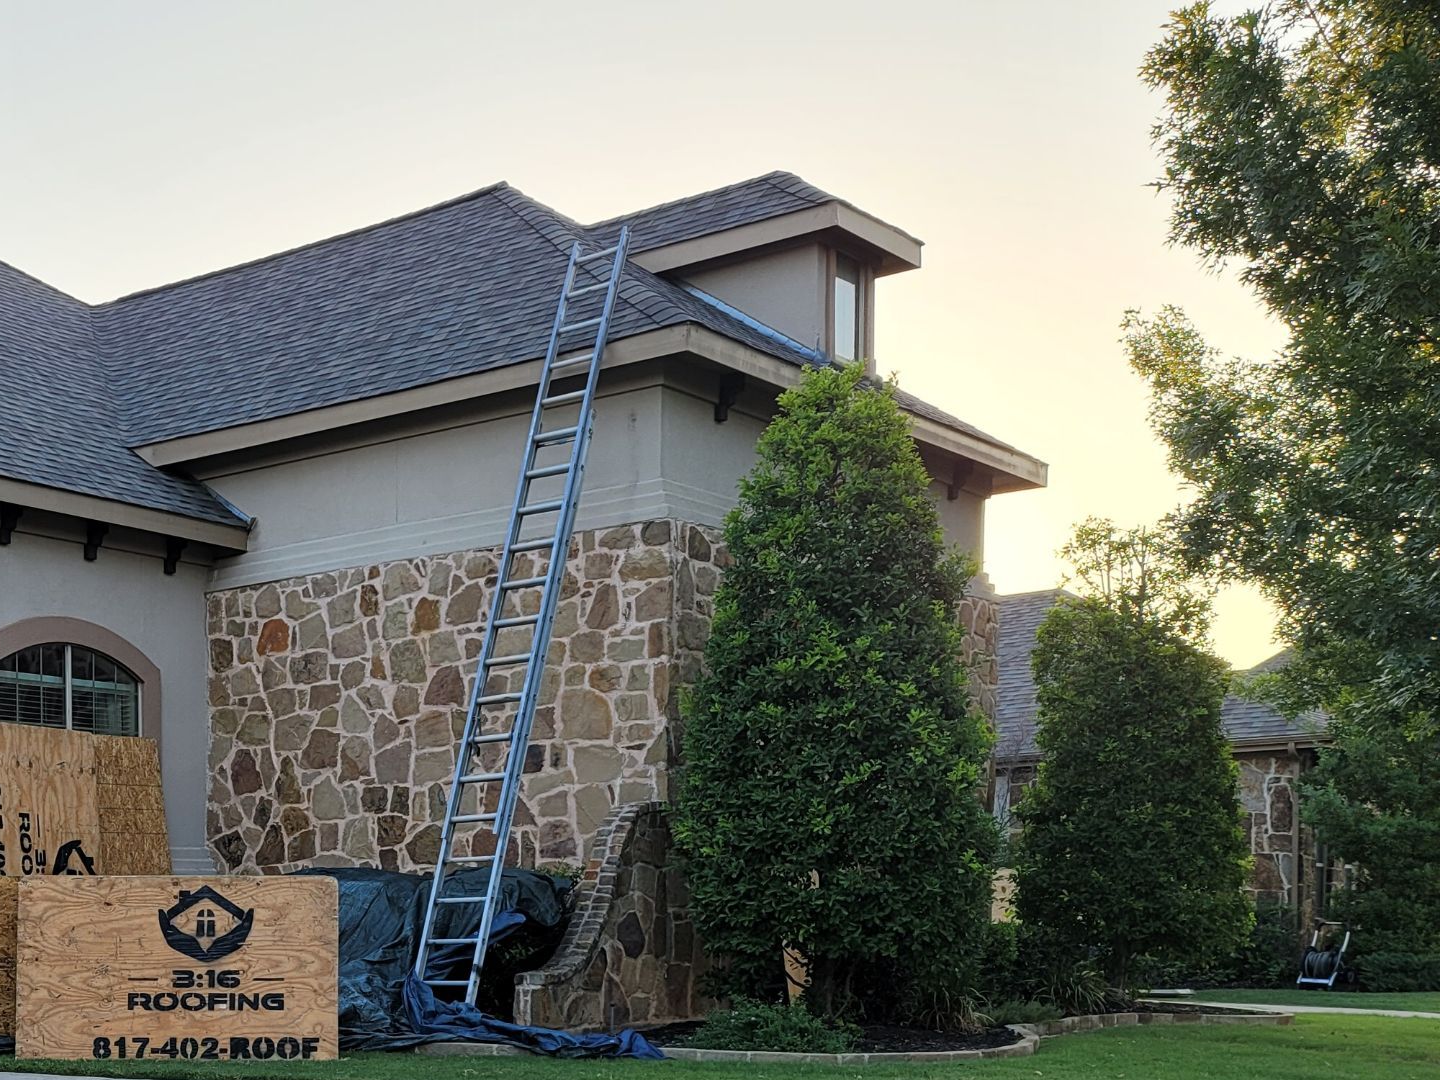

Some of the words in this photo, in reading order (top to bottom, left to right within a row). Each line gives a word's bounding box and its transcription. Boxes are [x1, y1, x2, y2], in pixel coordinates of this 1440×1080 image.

[172, 969, 241, 989] 3:16
[127, 992, 285, 1012] ROOFING
[92, 1036, 320, 1060] 817-402-ROOF
